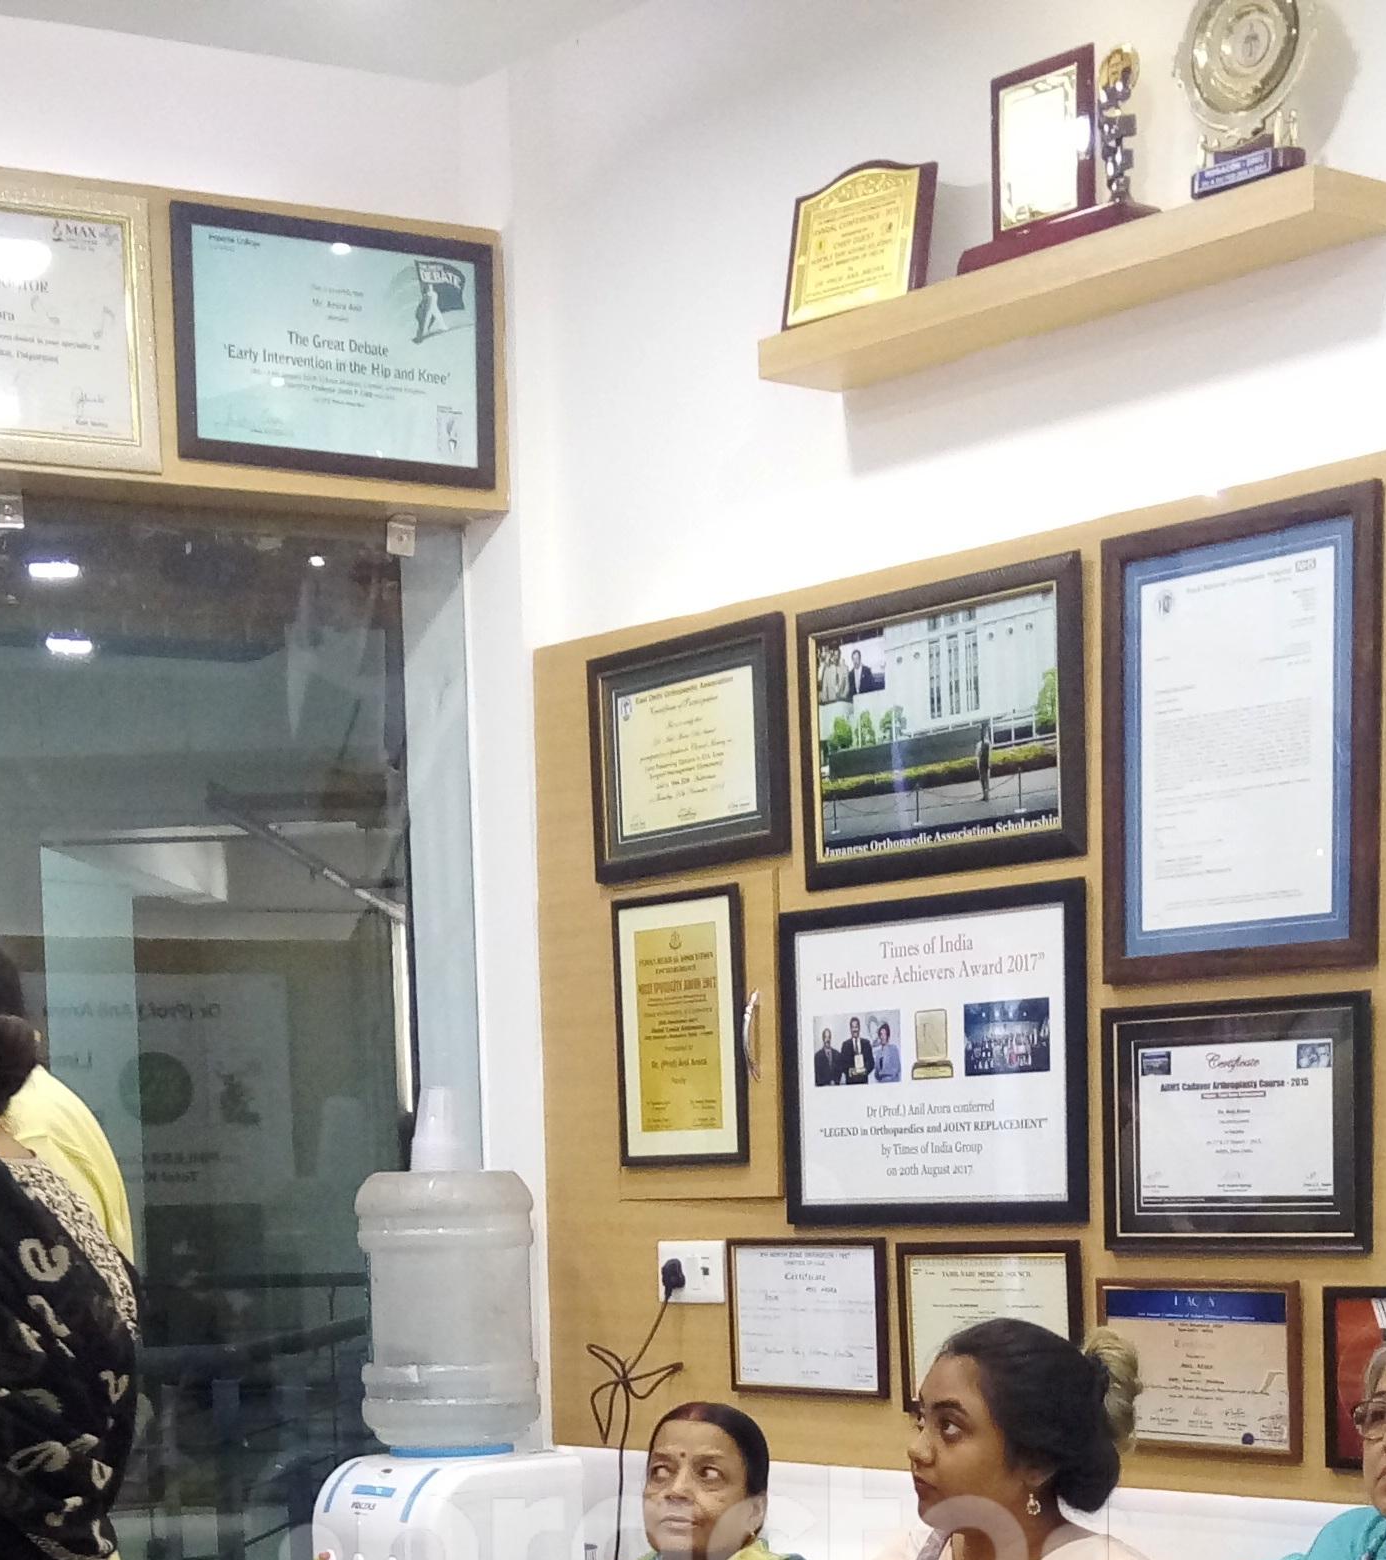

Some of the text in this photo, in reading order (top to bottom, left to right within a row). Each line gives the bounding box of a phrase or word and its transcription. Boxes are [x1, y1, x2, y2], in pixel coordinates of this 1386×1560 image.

[64, 223, 97, 239] MAX
[287, 330, 389, 357] The Great Debate
[263, 349, 332, 371] Intervention
[336, 358, 346, 372] in
[349, 360, 366, 375] the
[371, 362, 392, 379] Hip
[394, 365, 414, 381] and
[933, 825, 994, 843] Association
[879, 934, 973, 959] Times of India
[892, 964, 956, 985] Achievers
[958, 957, 1003, 978] Award
[1259, 1079, 1285, 1088] Course
[1291, 1078, 1309, 1087] 2015
[867, 1100, 995, 1118] Dr (Prof.) Anil Arora conferred
[860, 1126, 868, 1136] in
[870, 1123, 924, 1137] Orthopaedics
[927, 1122, 942, 1133] and
[943, 1121, 972, 1133] JOINT
[881, 1141, 983, 1158] by Times of India Group
[899, 1164, 919, 1177] 20th
[921, 1164, 950, 1178] August
